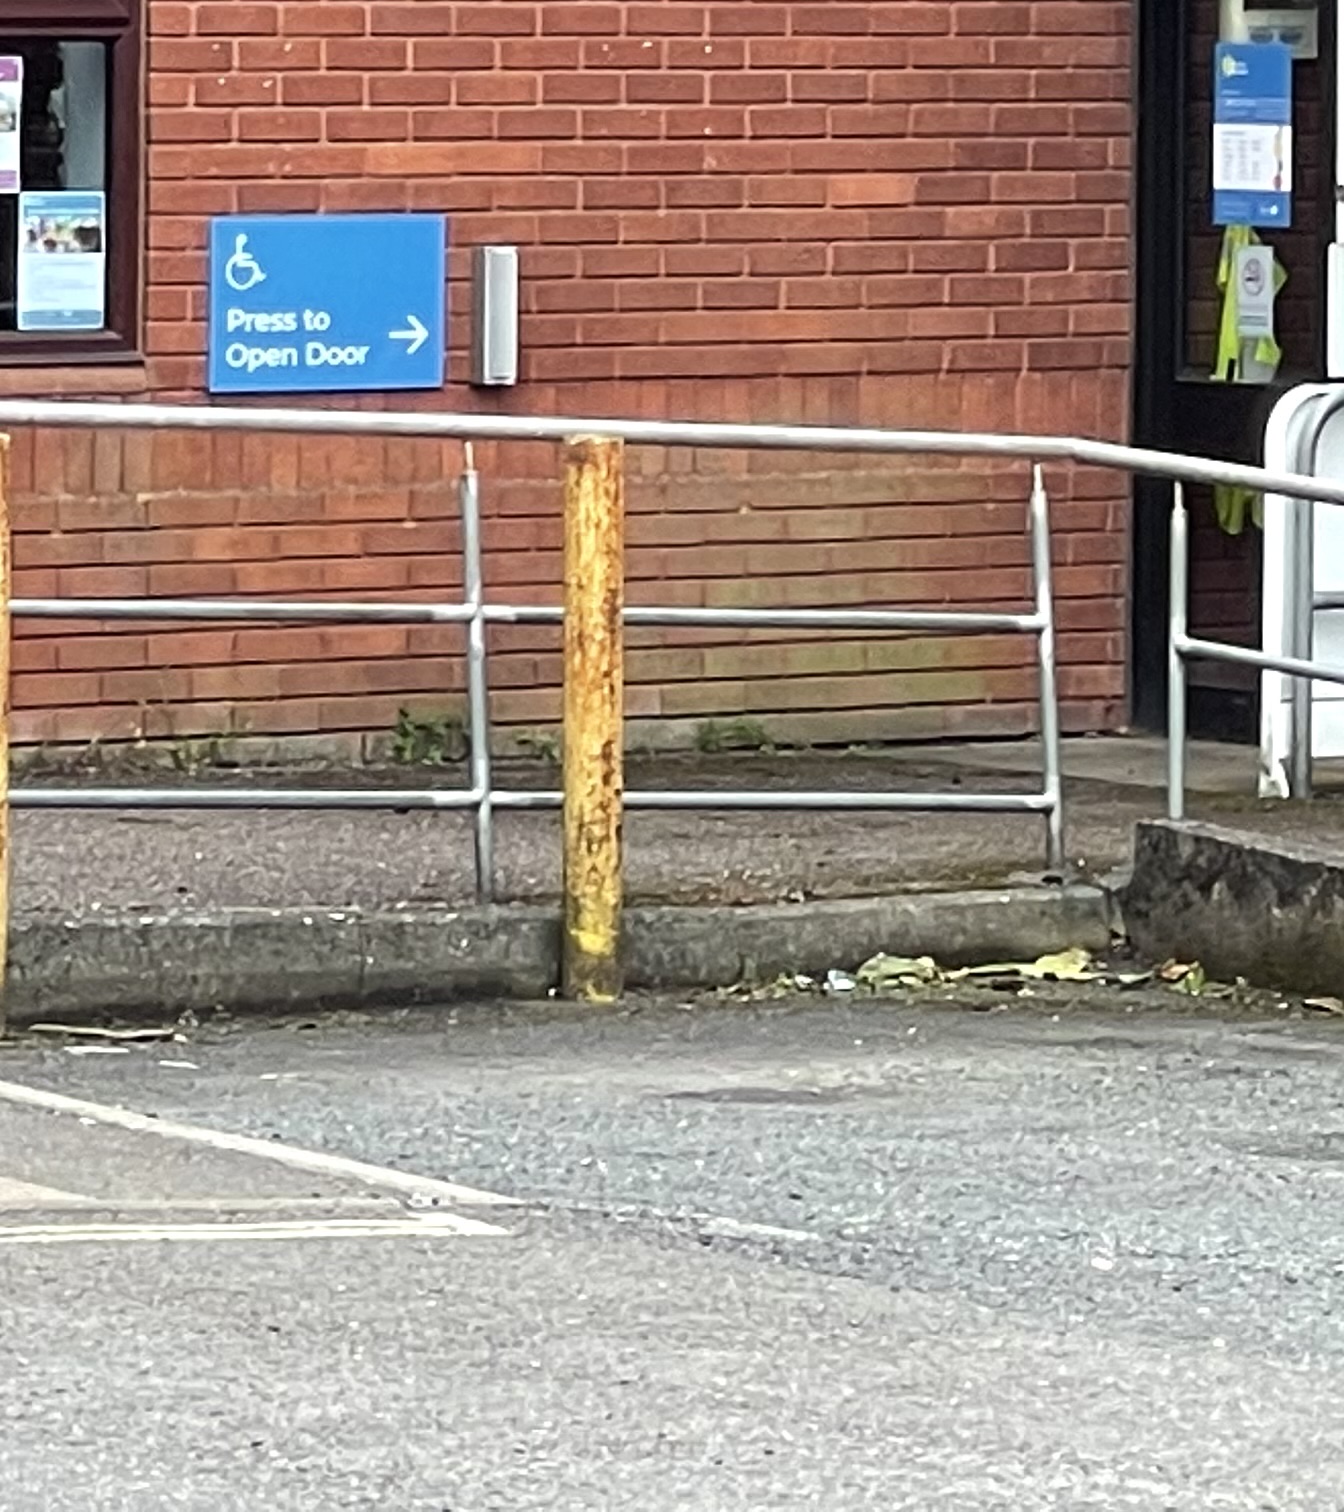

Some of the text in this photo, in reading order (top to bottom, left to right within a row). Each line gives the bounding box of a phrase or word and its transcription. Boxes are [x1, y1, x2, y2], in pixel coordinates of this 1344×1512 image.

[227, 308, 331, 333] Press to
[226, 341, 371, 373] Open Door
